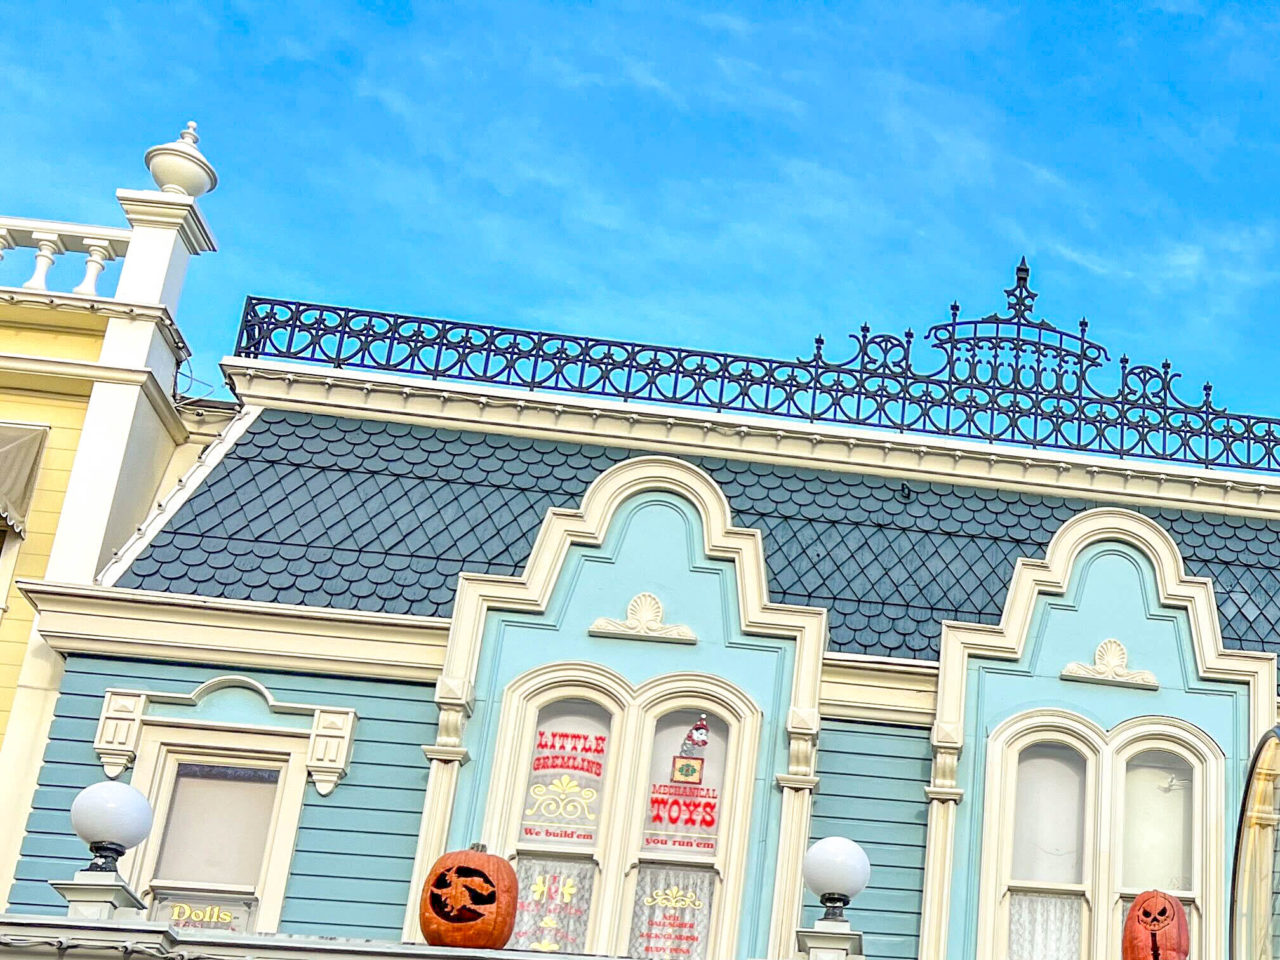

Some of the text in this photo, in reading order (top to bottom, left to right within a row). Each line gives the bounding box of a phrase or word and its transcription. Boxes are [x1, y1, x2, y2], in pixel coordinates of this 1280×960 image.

[537, 730, 606, 754] LITTLE
[533, 755, 603, 777] GREMLINS
[651, 784, 718, 799] MECHANICAL
[650, 797, 717, 828] TOYS
[524, 827, 543, 838] We
[645, 837, 668, 847] you
[171, 903, 233, 923] Dolls
